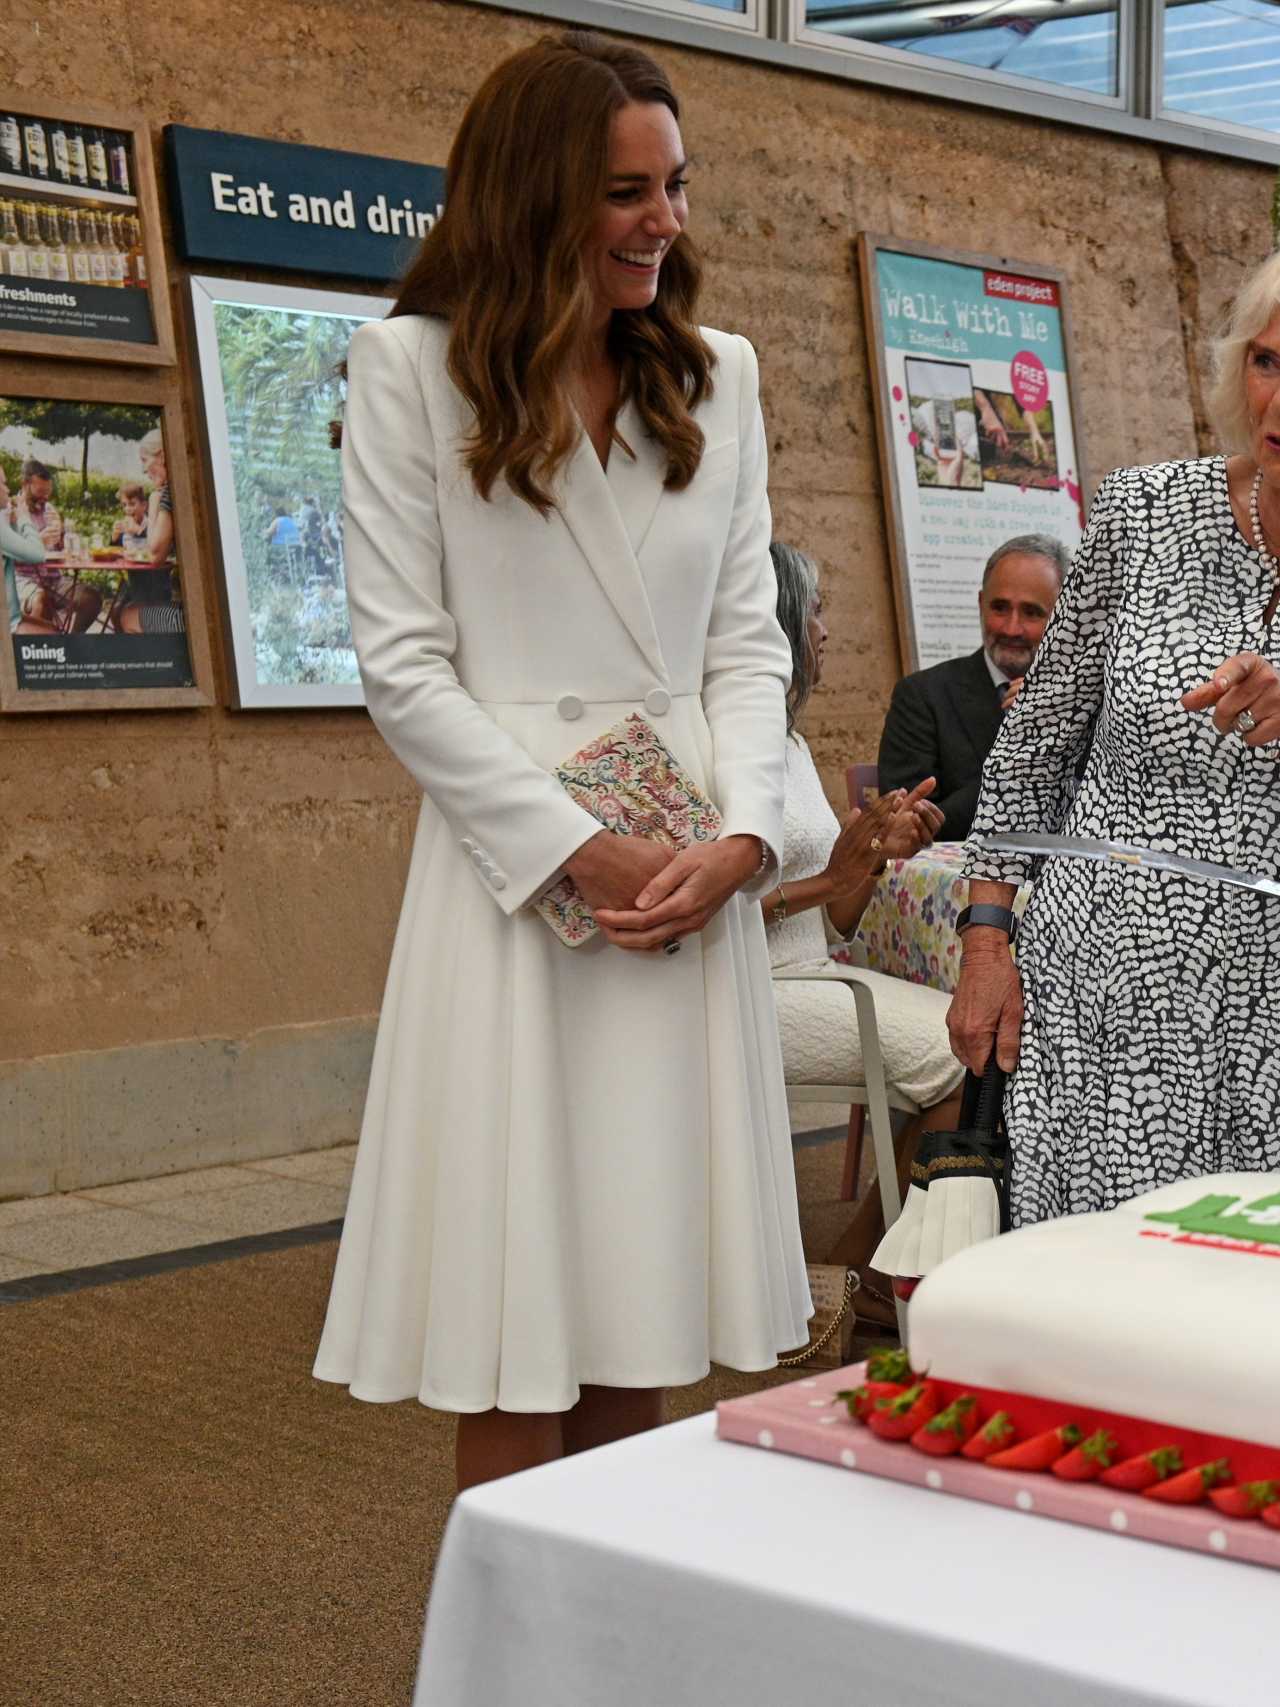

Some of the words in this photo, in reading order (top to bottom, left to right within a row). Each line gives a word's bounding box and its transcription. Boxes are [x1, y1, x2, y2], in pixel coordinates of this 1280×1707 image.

[211, 172, 278, 218] Eat
[289, 190, 356, 229] and
[987, 276, 1014, 293] eden
[1014, 282, 1053, 301] project
[882, 288, 948, 326] Walk
[953, 299, 1013, 338] With
[1018, 310, 1048, 342] Me
[1014, 361, 1046, 386] FREE
[21, 643, 66, 663] Dining
